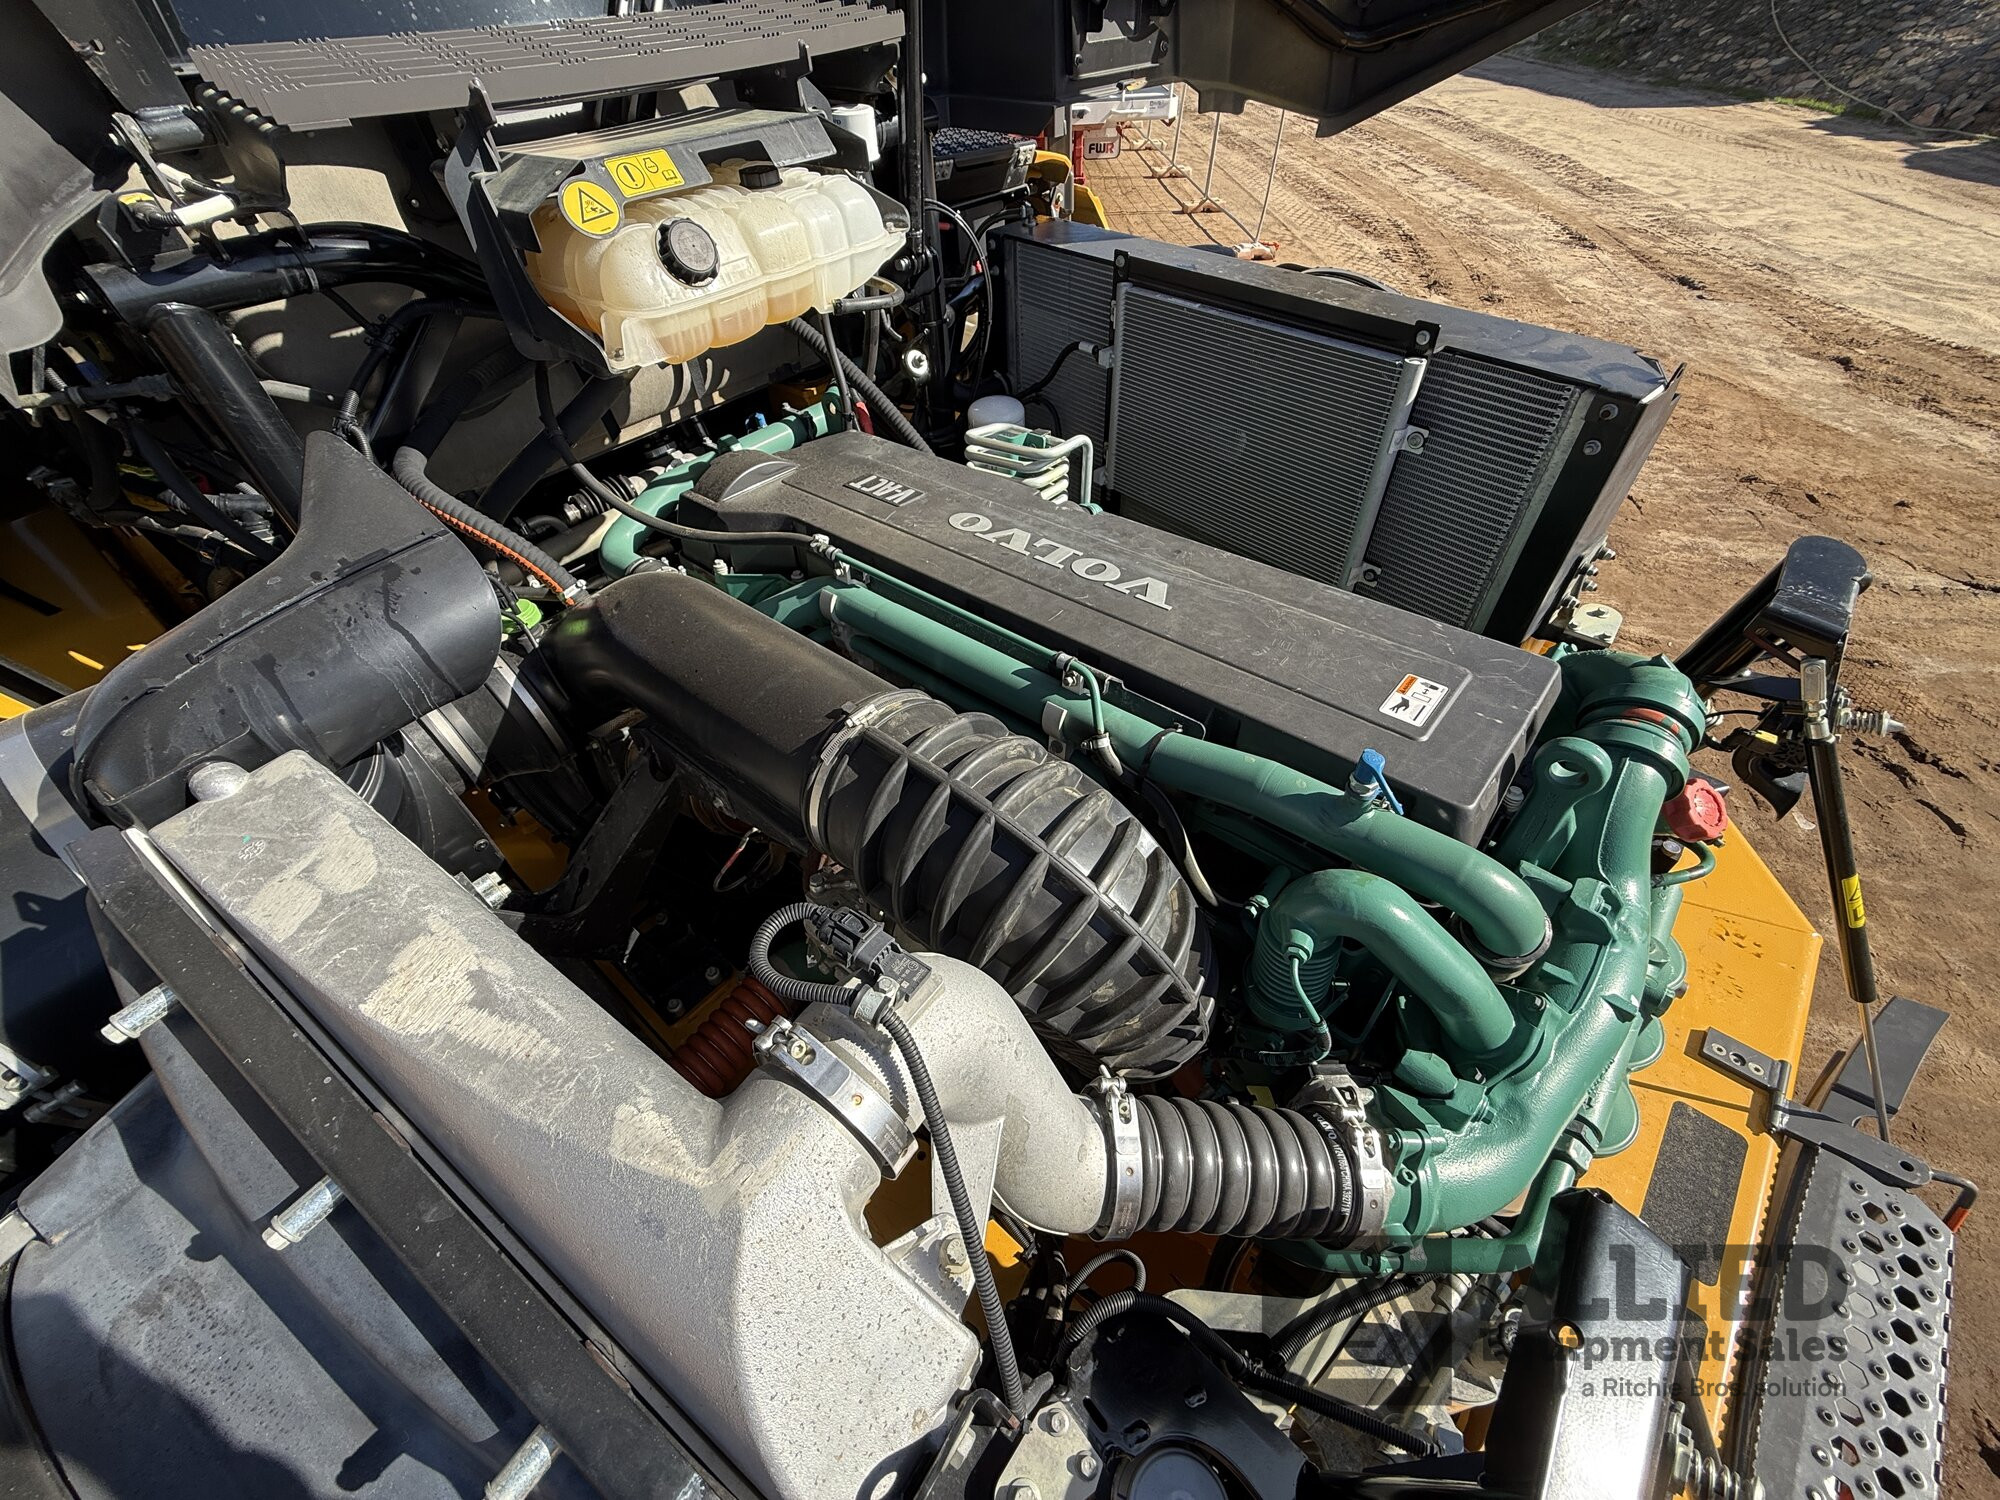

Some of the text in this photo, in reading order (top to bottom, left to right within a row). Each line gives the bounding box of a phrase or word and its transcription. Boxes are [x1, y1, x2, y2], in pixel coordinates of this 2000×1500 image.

[1088, 142, 1115, 154] FWR
[848, 475, 916, 504] V-ACT
[948, 512, 1173, 611] VOLVO
